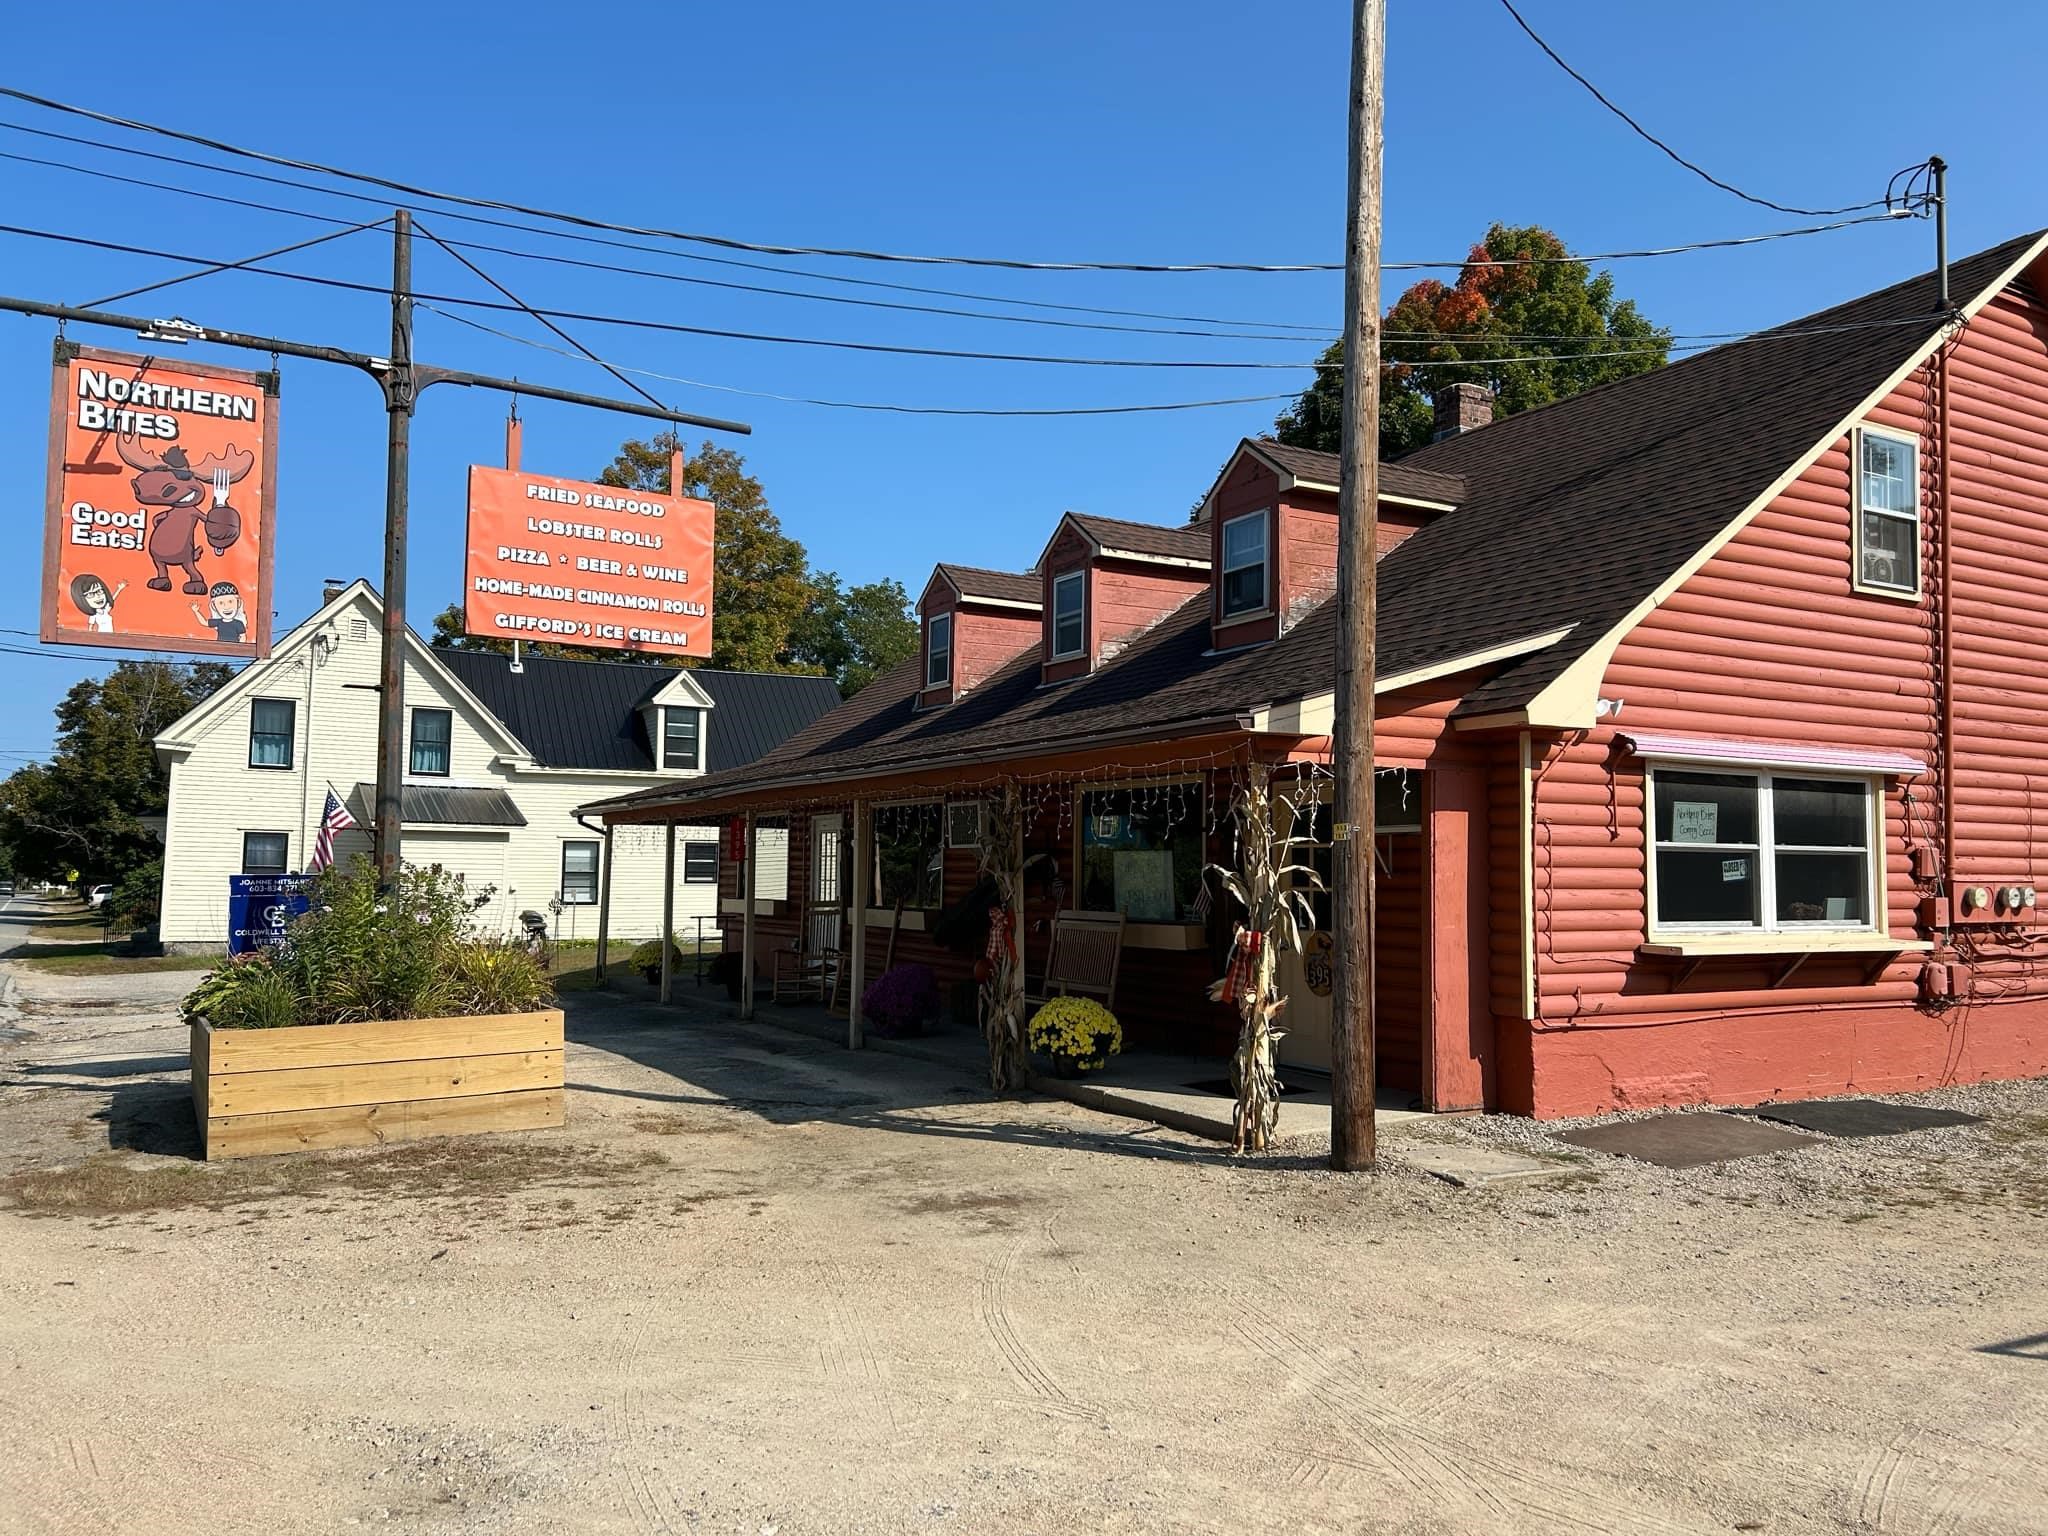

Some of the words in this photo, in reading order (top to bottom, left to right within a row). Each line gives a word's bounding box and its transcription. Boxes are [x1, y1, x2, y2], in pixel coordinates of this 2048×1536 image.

[78, 368, 256, 422] NORTHERN
[78, 399, 179, 440] BITES
[71, 502, 147, 529] Good
[526, 484, 580, 505] FRIED
[584, 493, 665, 518] SEAFOOD
[71, 524, 145, 550] Eats!
[527, 517, 606, 542] LOBSTER
[609, 529, 663, 549] ROLLS
[497, 546, 550, 567] PIZZA
[576, 556, 622, 575] BEER
[626, 564, 638, 578] &
[642, 565, 688, 584] WINE
[474, 576, 574, 602] HOME-MADE
[576, 589, 659, 612] CINNAMON
[662, 600, 706, 617] ROLLS
[495, 613, 592, 637] GIFFORD'S
[595, 624, 624, 640] ICE
[628, 627, 687, 646] CREAM
[1724, 862, 1739, 873] CLOSED
